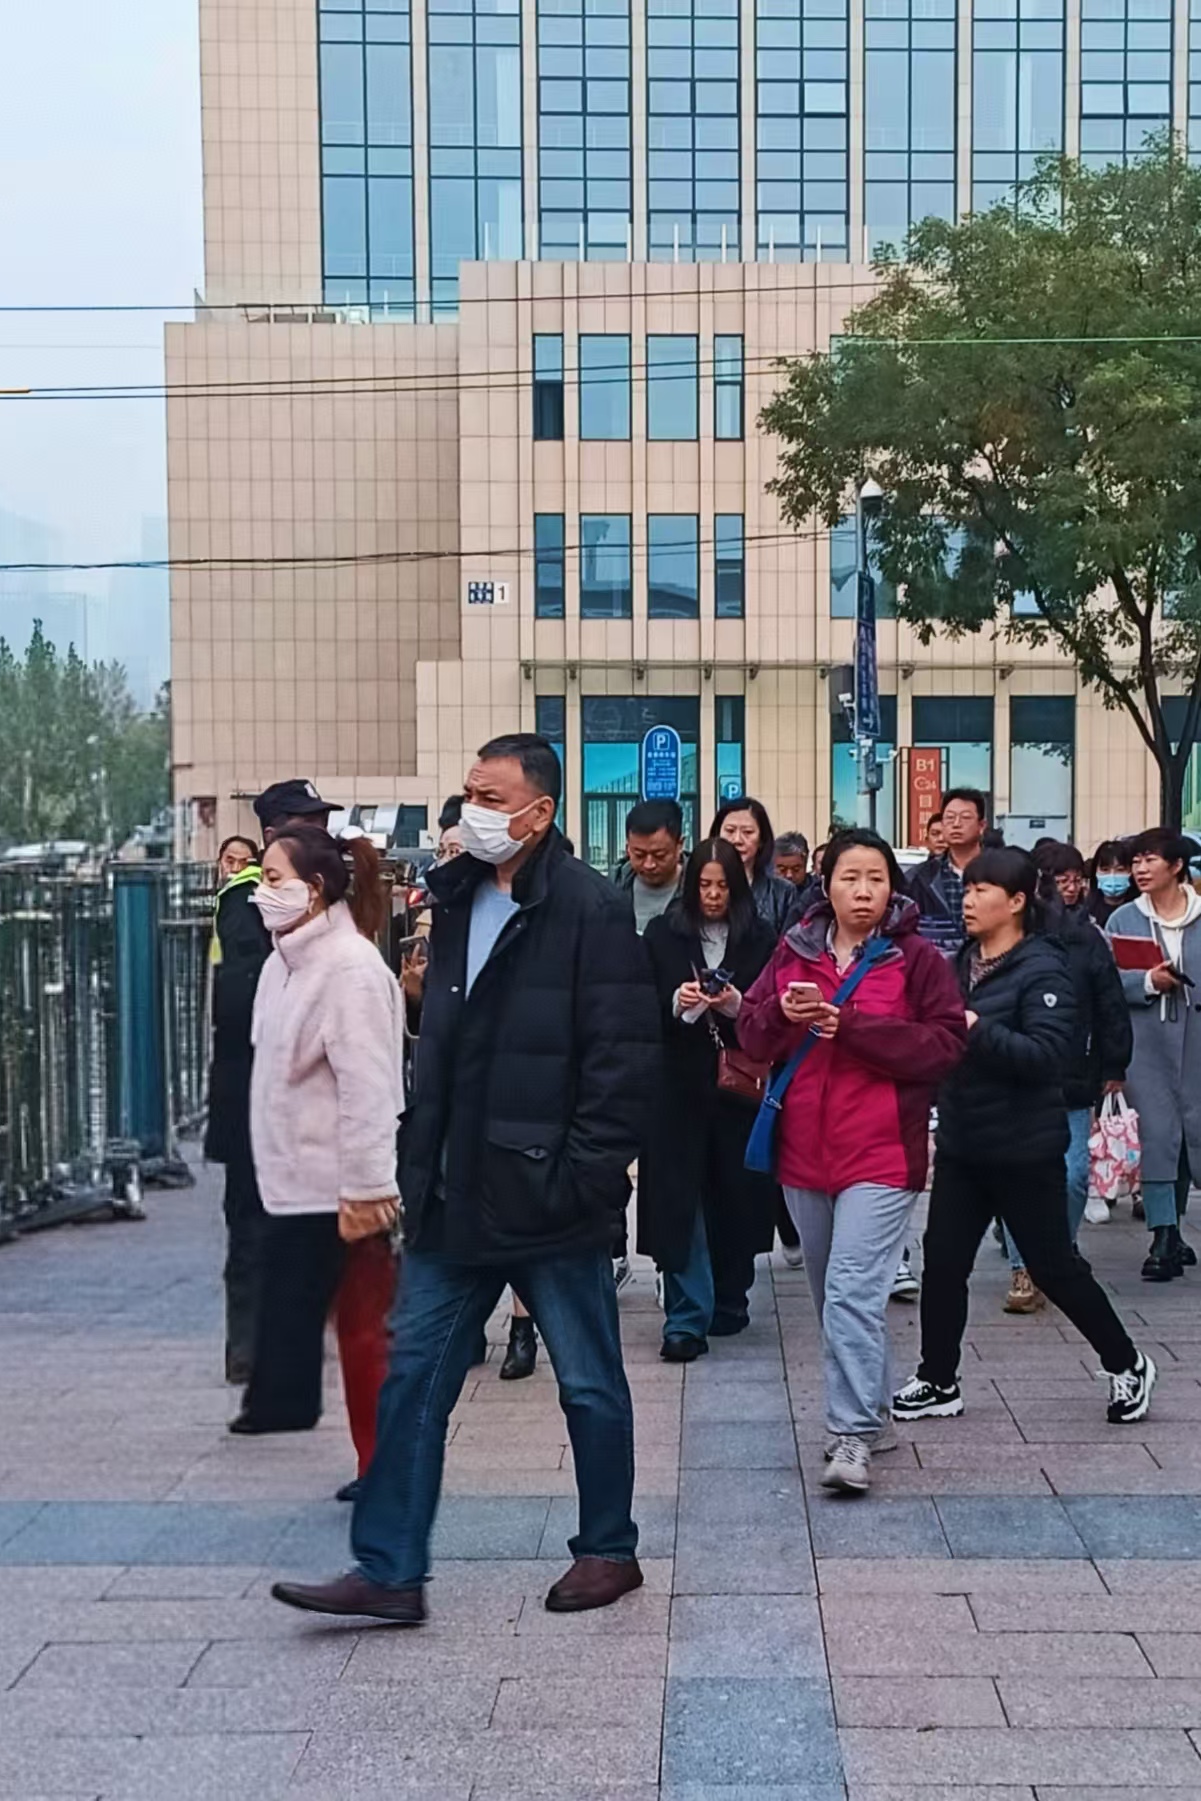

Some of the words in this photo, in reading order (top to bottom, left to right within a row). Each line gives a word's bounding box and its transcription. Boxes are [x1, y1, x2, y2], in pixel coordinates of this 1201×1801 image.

[656, 734, 666, 750] P
[915, 758, 935, 772] B1
[728, 784, 739, 799] P
